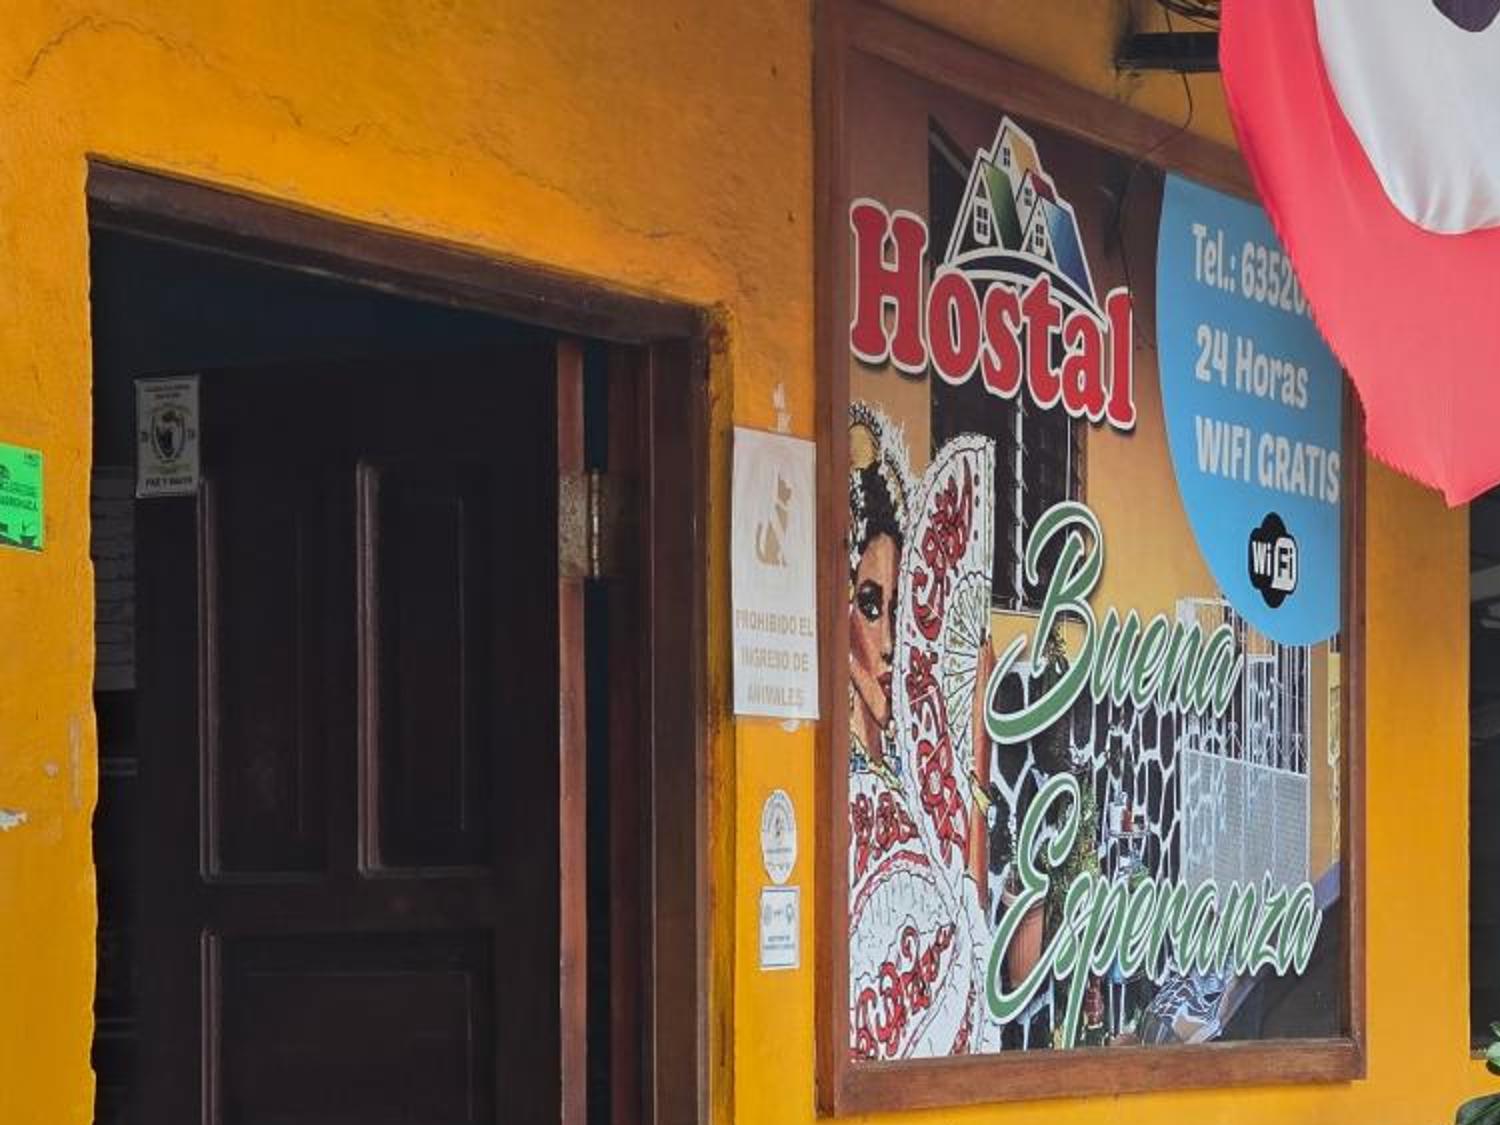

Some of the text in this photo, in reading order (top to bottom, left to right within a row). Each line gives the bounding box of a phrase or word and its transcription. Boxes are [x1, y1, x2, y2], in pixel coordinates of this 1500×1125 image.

[850, 198, 1136, 430] Hostal
[1191, 222, 1236, 293] Tel.:
[1195, 324, 1309, 409] 24 Horas
[1195, 415, 1341, 504] WIFI GRATIS
[983, 501, 1245, 745] Buena
[984, 773, 1322, 1050] Esperanza
